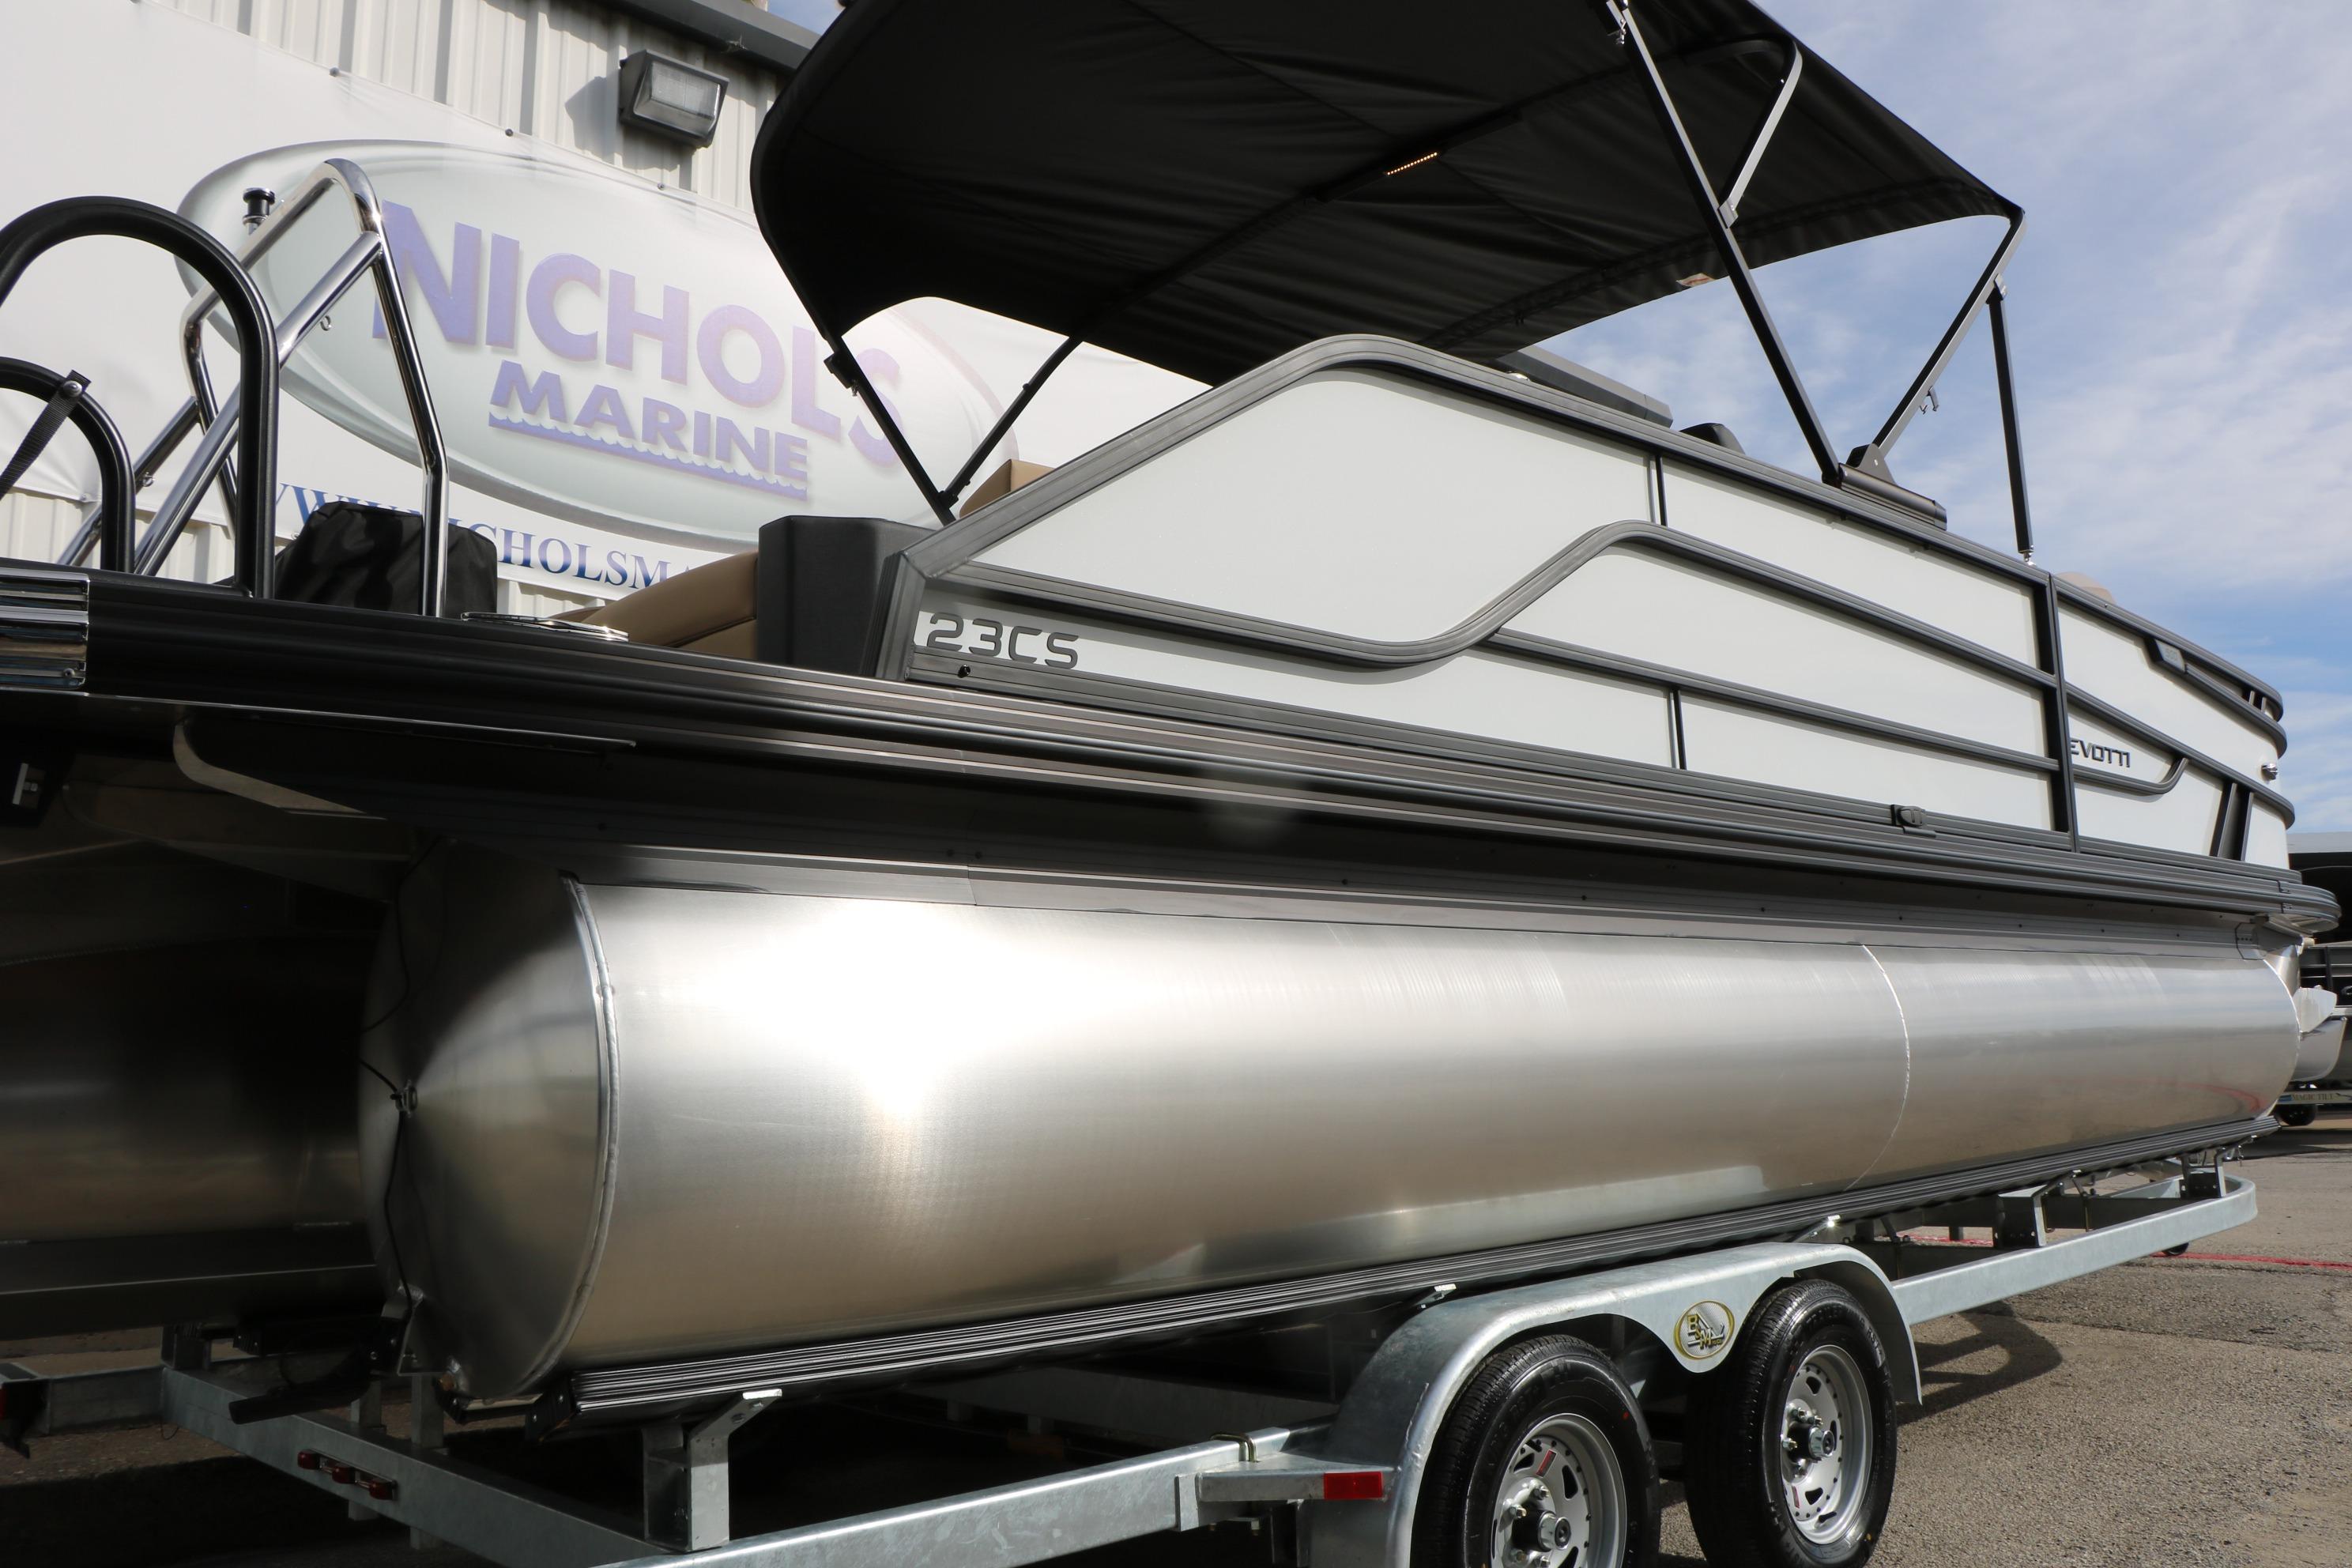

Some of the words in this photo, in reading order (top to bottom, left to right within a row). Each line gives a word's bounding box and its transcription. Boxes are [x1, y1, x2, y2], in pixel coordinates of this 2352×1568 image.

[372, 199, 904, 469] NICHOLS
[489, 359, 808, 482] MARINE
[926, 611, 1080, 669] 23CS
